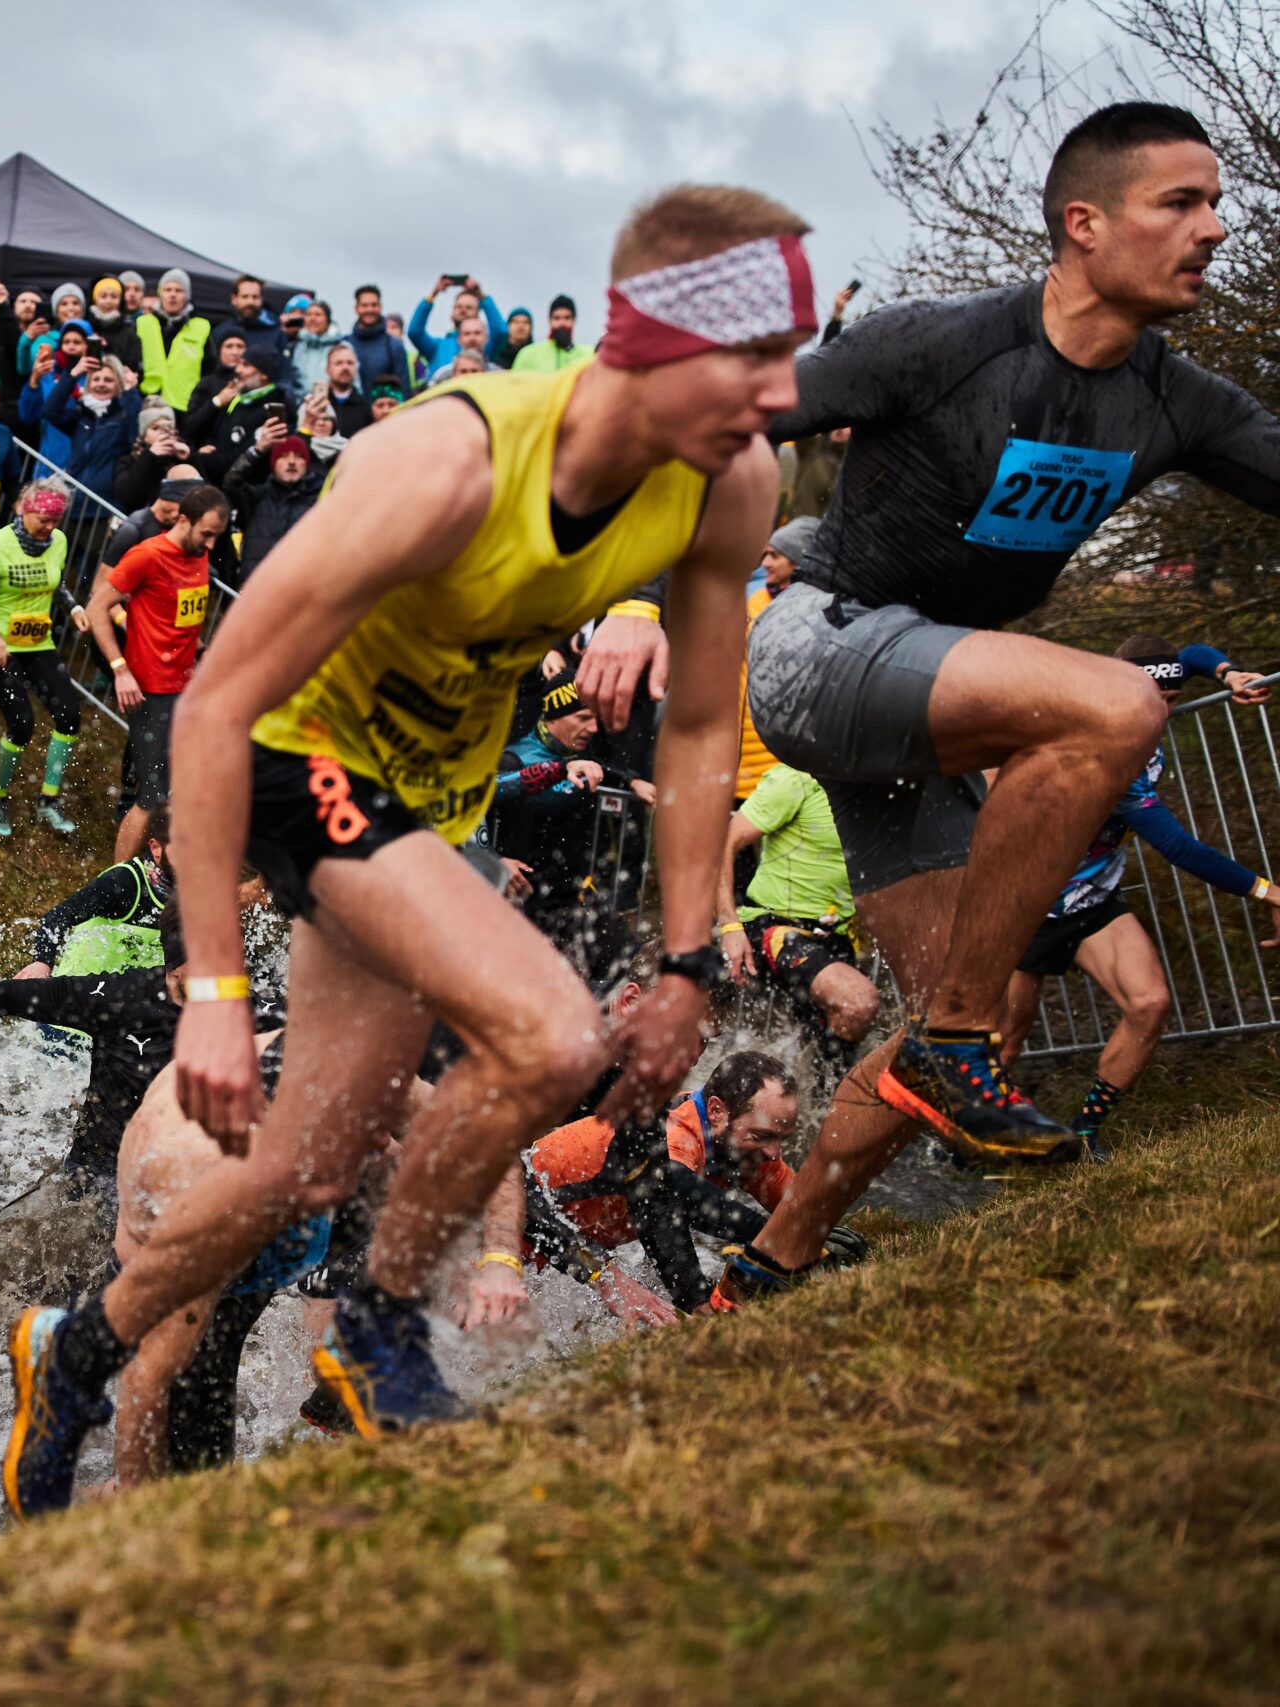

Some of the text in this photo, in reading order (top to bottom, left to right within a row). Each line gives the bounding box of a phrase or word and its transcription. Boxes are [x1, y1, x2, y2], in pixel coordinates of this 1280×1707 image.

[1029, 461, 1107, 479] LEGEND OF CROSS
[989, 471, 1112, 525] 2701
[11, 621, 49, 637] 3060
